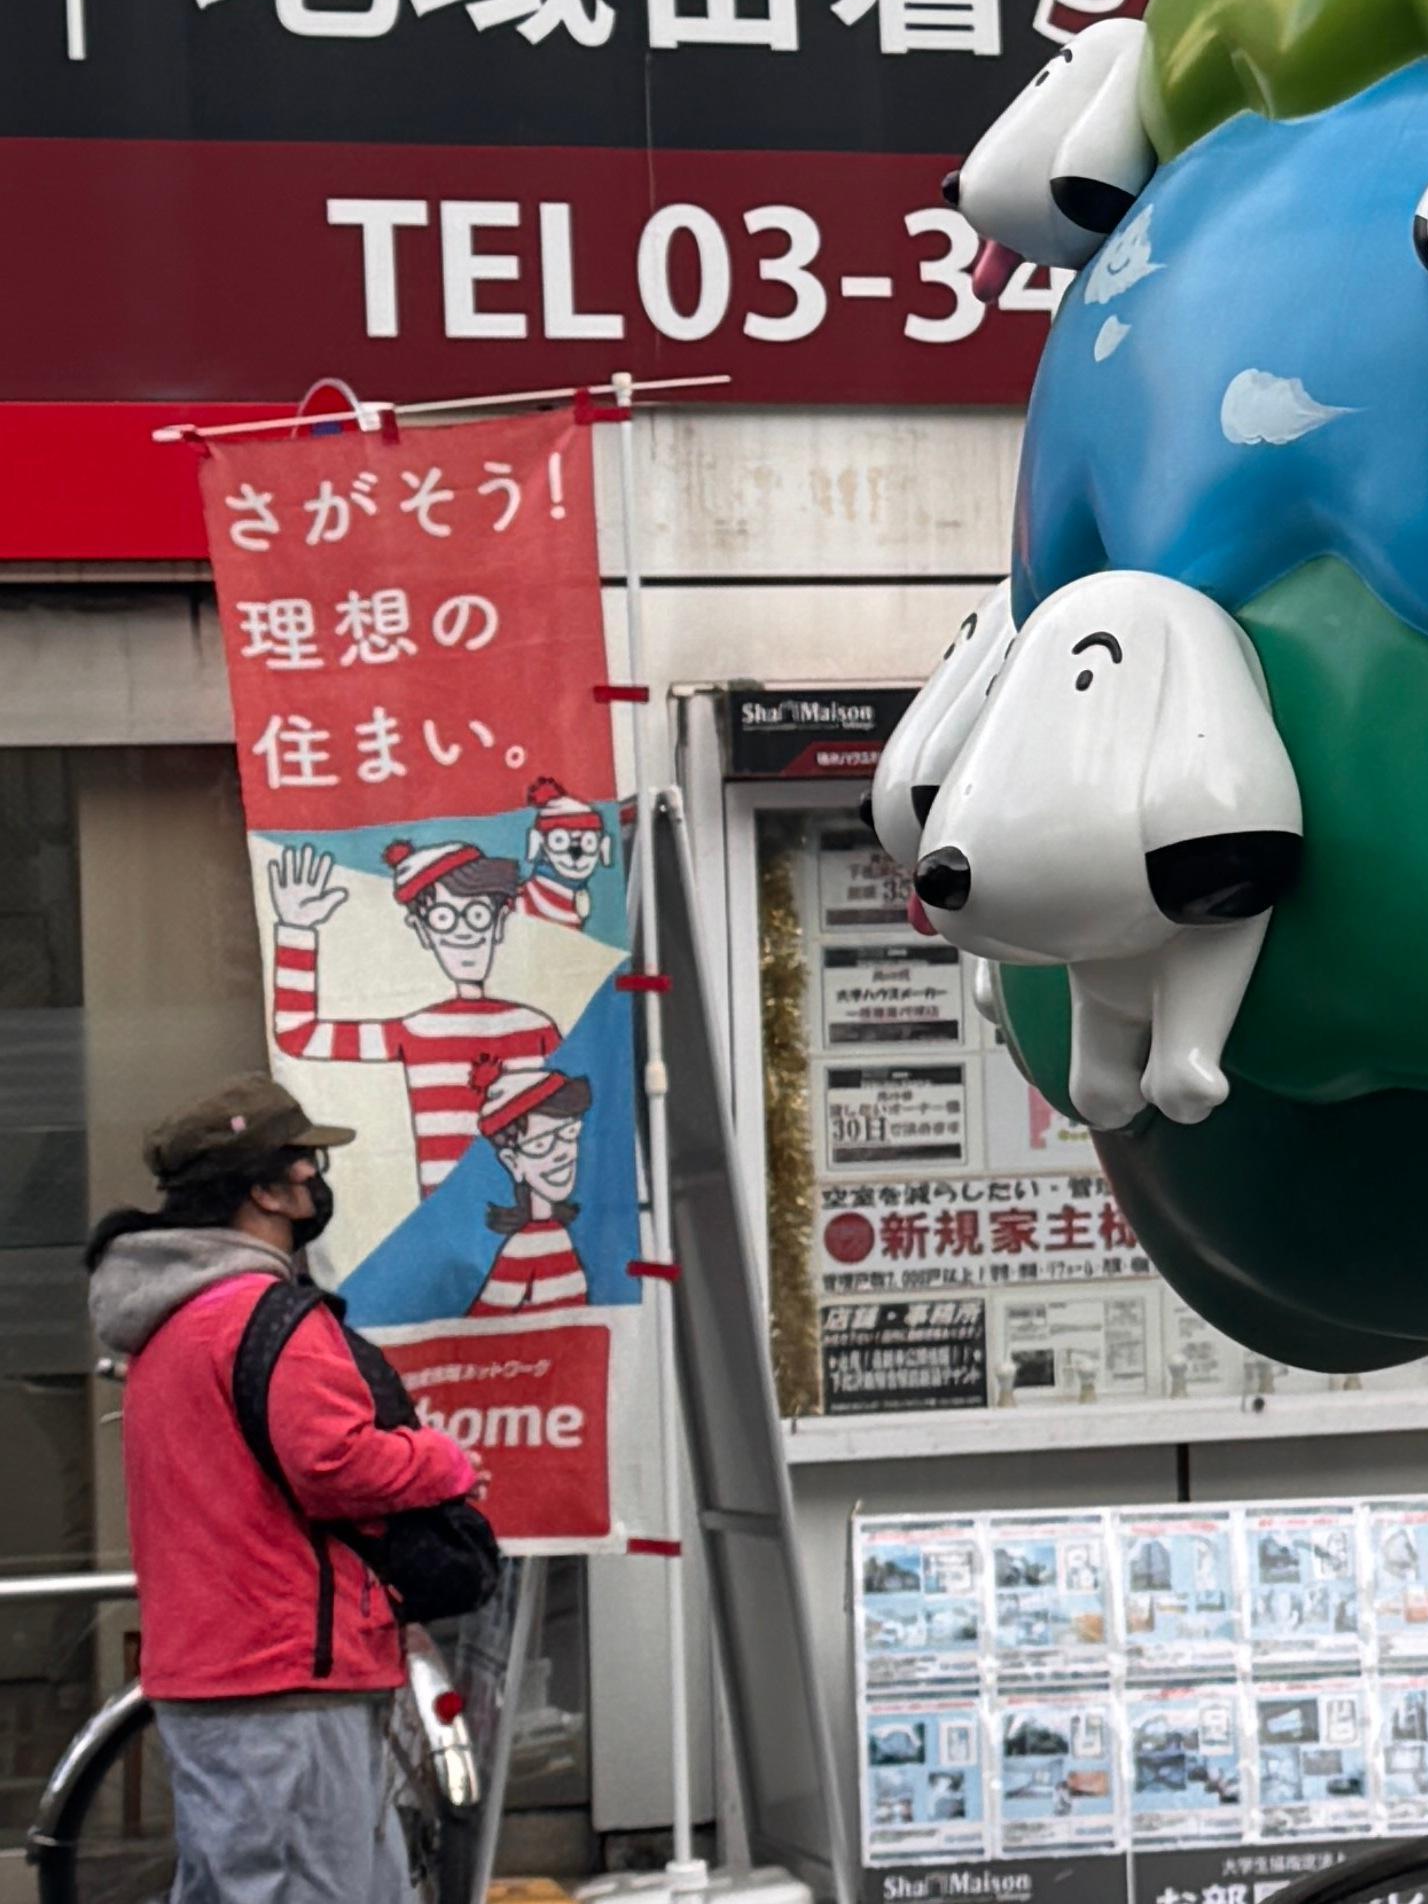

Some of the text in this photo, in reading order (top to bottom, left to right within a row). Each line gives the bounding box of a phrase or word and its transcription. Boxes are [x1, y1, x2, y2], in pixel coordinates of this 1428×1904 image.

[224, 450, 568, 553] さがそう!
[236, 587, 500, 672] 理想の
[251, 705, 528, 791] 住まい。
